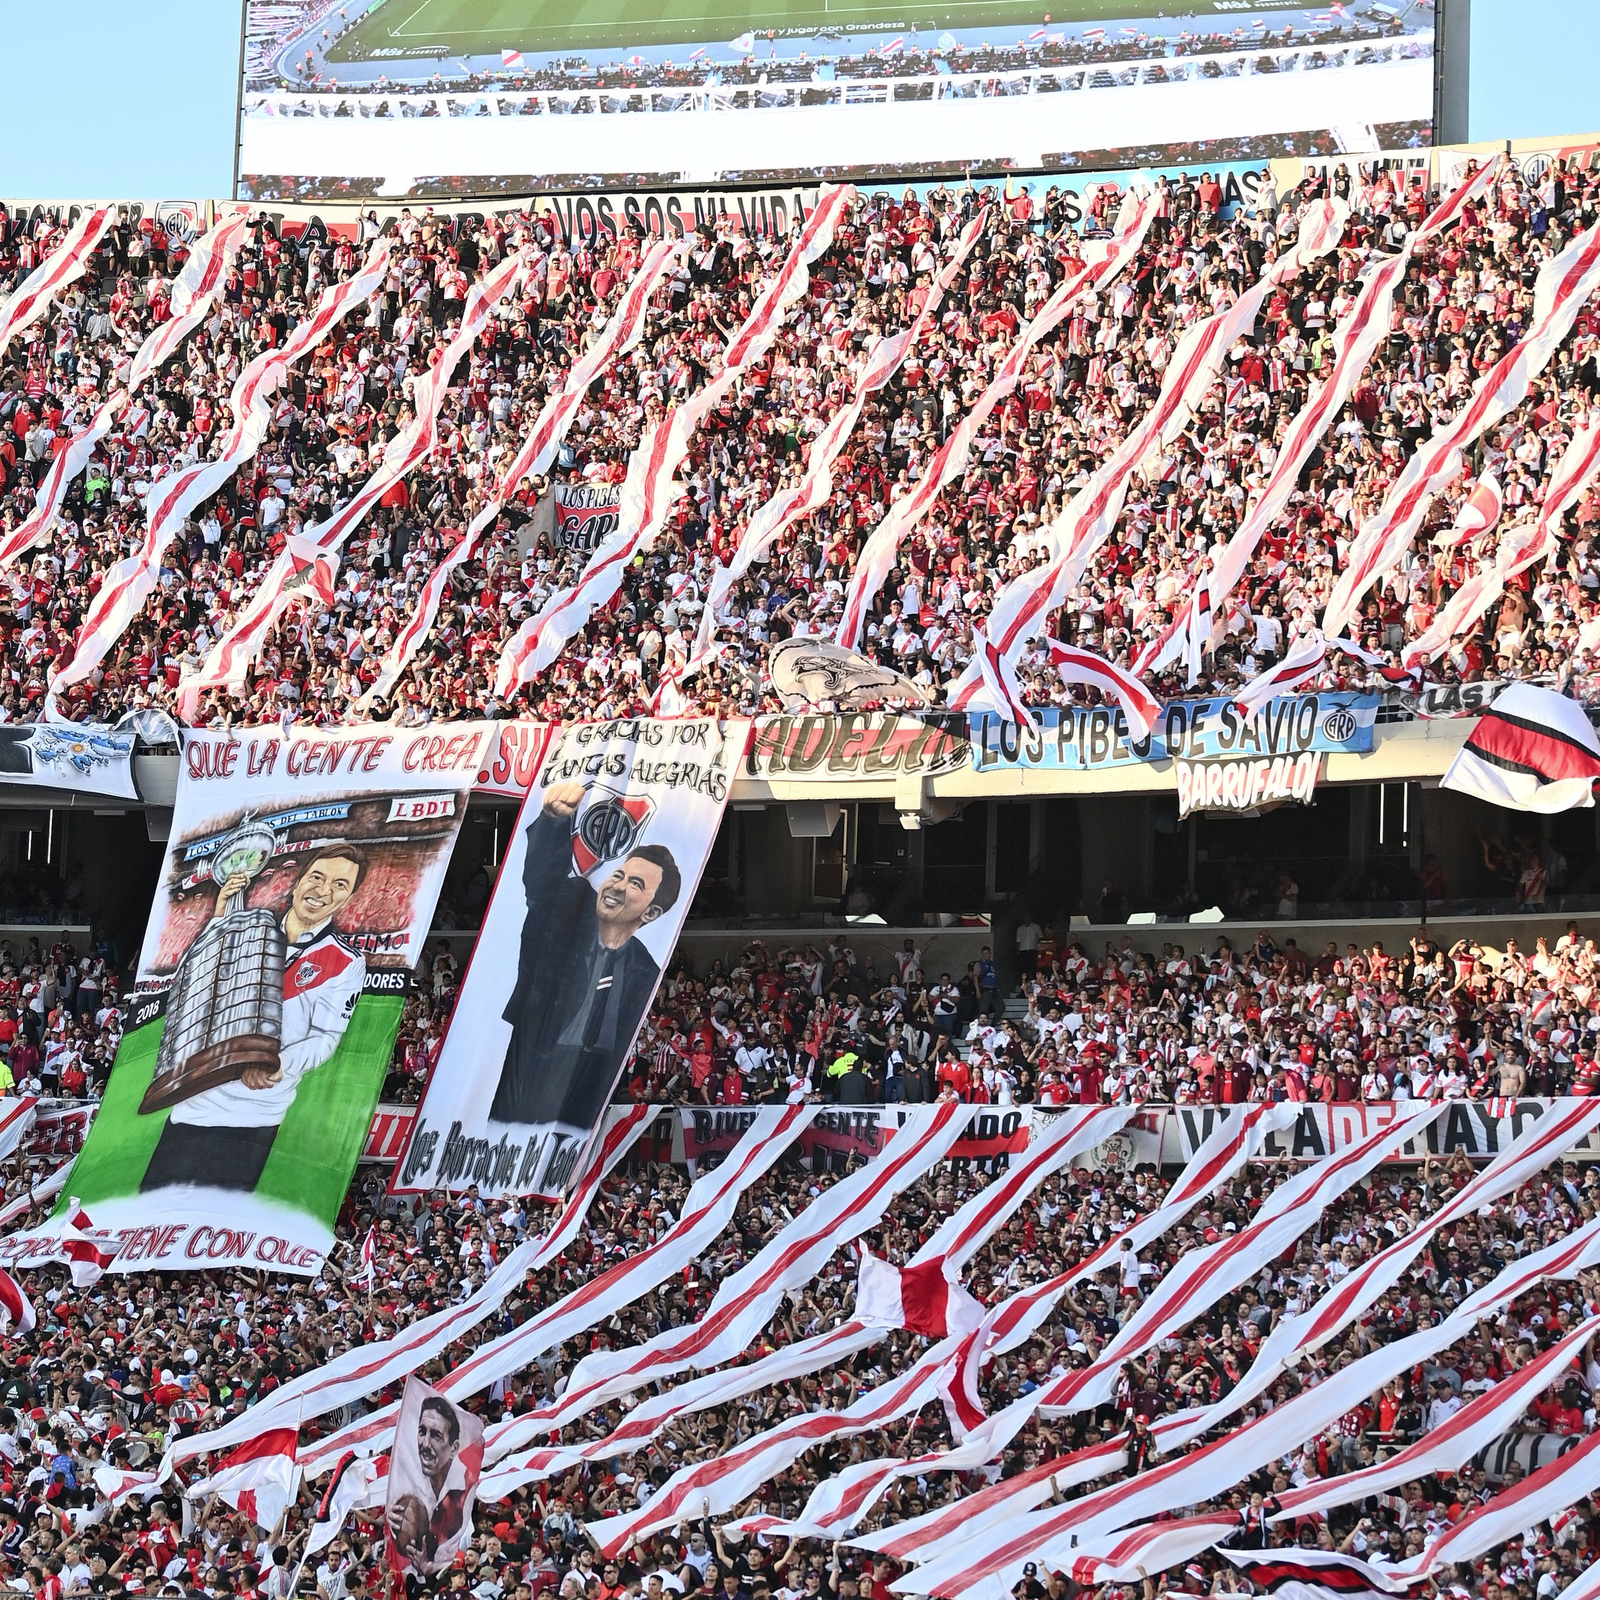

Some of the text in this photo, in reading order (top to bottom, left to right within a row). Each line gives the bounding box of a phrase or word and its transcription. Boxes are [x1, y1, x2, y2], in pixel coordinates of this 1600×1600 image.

[787, 26, 818, 35] jugar
[552, 197, 616, 250] VOS
[562, 485, 622, 509] LOS PIBES
[1427, 684, 1484, 713] LAS
[576, 719, 710, 749] GRACIAS POR
[981, 710, 1045, 766] LOS
[1166, 703, 1211, 757] DE
[1217, 695, 1320, 754] SAVIO
[187, 739, 241, 780] QUE
[247, 737, 281, 778] LA
[287, 737, 394, 779] GENTE
[541, 753, 727, 804] TANTAS ALEGRIAS
[280, 816, 298, 826] DEL
[303, 807, 344, 821] TABLON
[190, 844, 210, 857] LOS
[136, 1000, 160, 1024] 2018
[813, 1111, 880, 1148] GENTE
[118, 1224, 188, 1260] TIENE
[187, 1226, 257, 1259] CON
[255, 1236, 321, 1267] QUE
